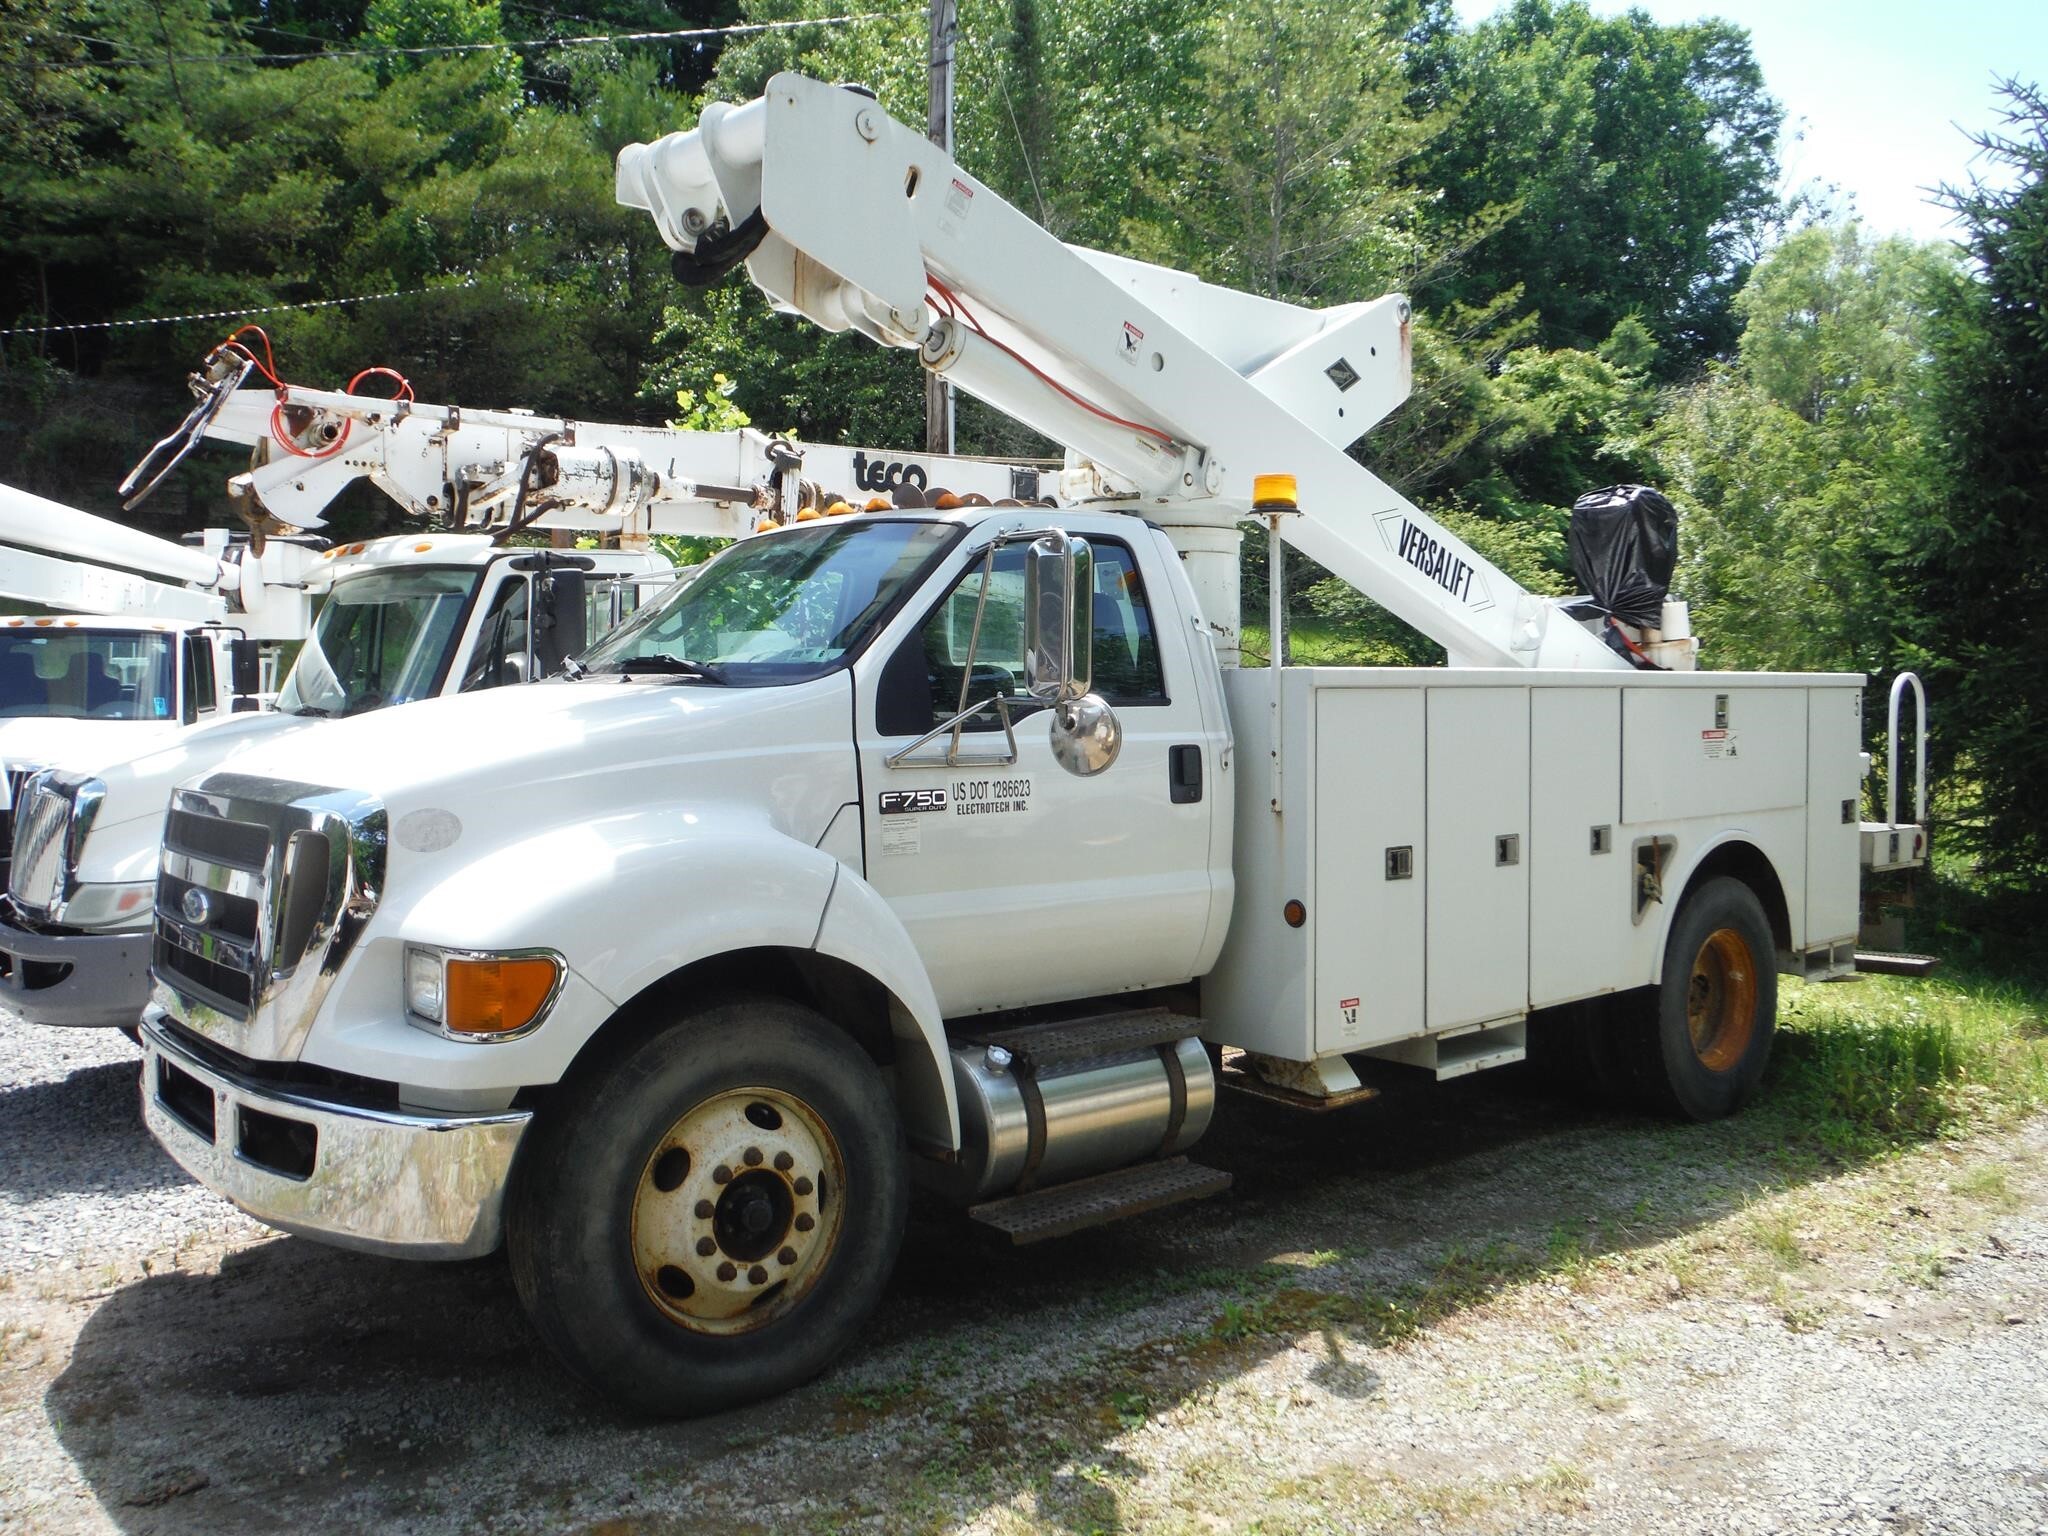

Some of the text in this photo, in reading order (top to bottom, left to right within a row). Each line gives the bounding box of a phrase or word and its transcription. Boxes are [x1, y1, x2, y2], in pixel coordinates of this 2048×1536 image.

[853, 451, 927, 493] teco
[1398, 518, 1474, 602] VERSALIFT
[952, 779, 1031, 801] US DOT 1286623
[957, 800, 1029, 815] ELECTROTECH INC.
